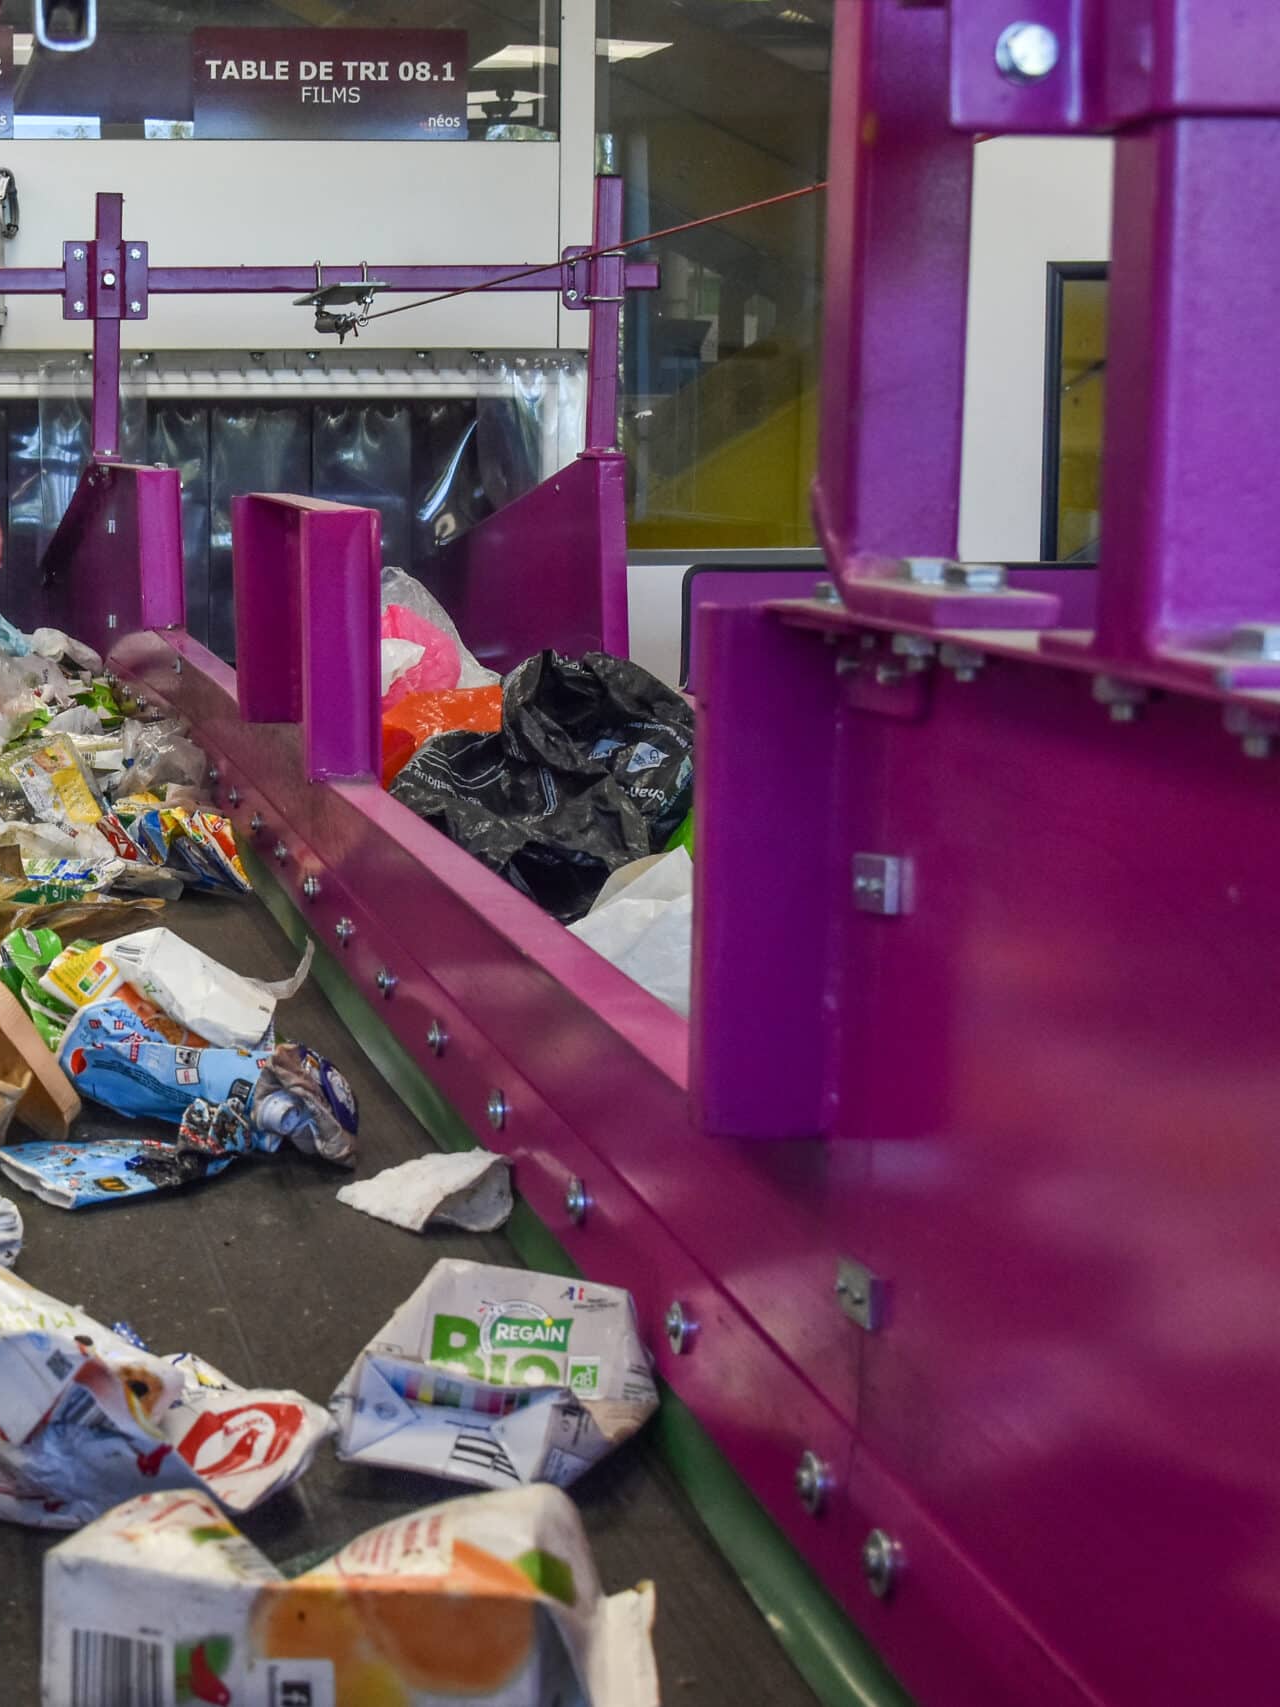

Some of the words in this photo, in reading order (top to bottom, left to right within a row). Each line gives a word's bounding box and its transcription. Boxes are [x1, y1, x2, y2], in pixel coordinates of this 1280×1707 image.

[205, 60, 289, 81] TABLE
[299, 61, 333, 81] DE
[342, 62, 389, 81] TRI
[398, 62, 455, 82] 08.1
[301, 87, 361, 103] FILMS
[428, 116, 460, 128] néos
[495, 1322, 565, 1344] REGAIN
